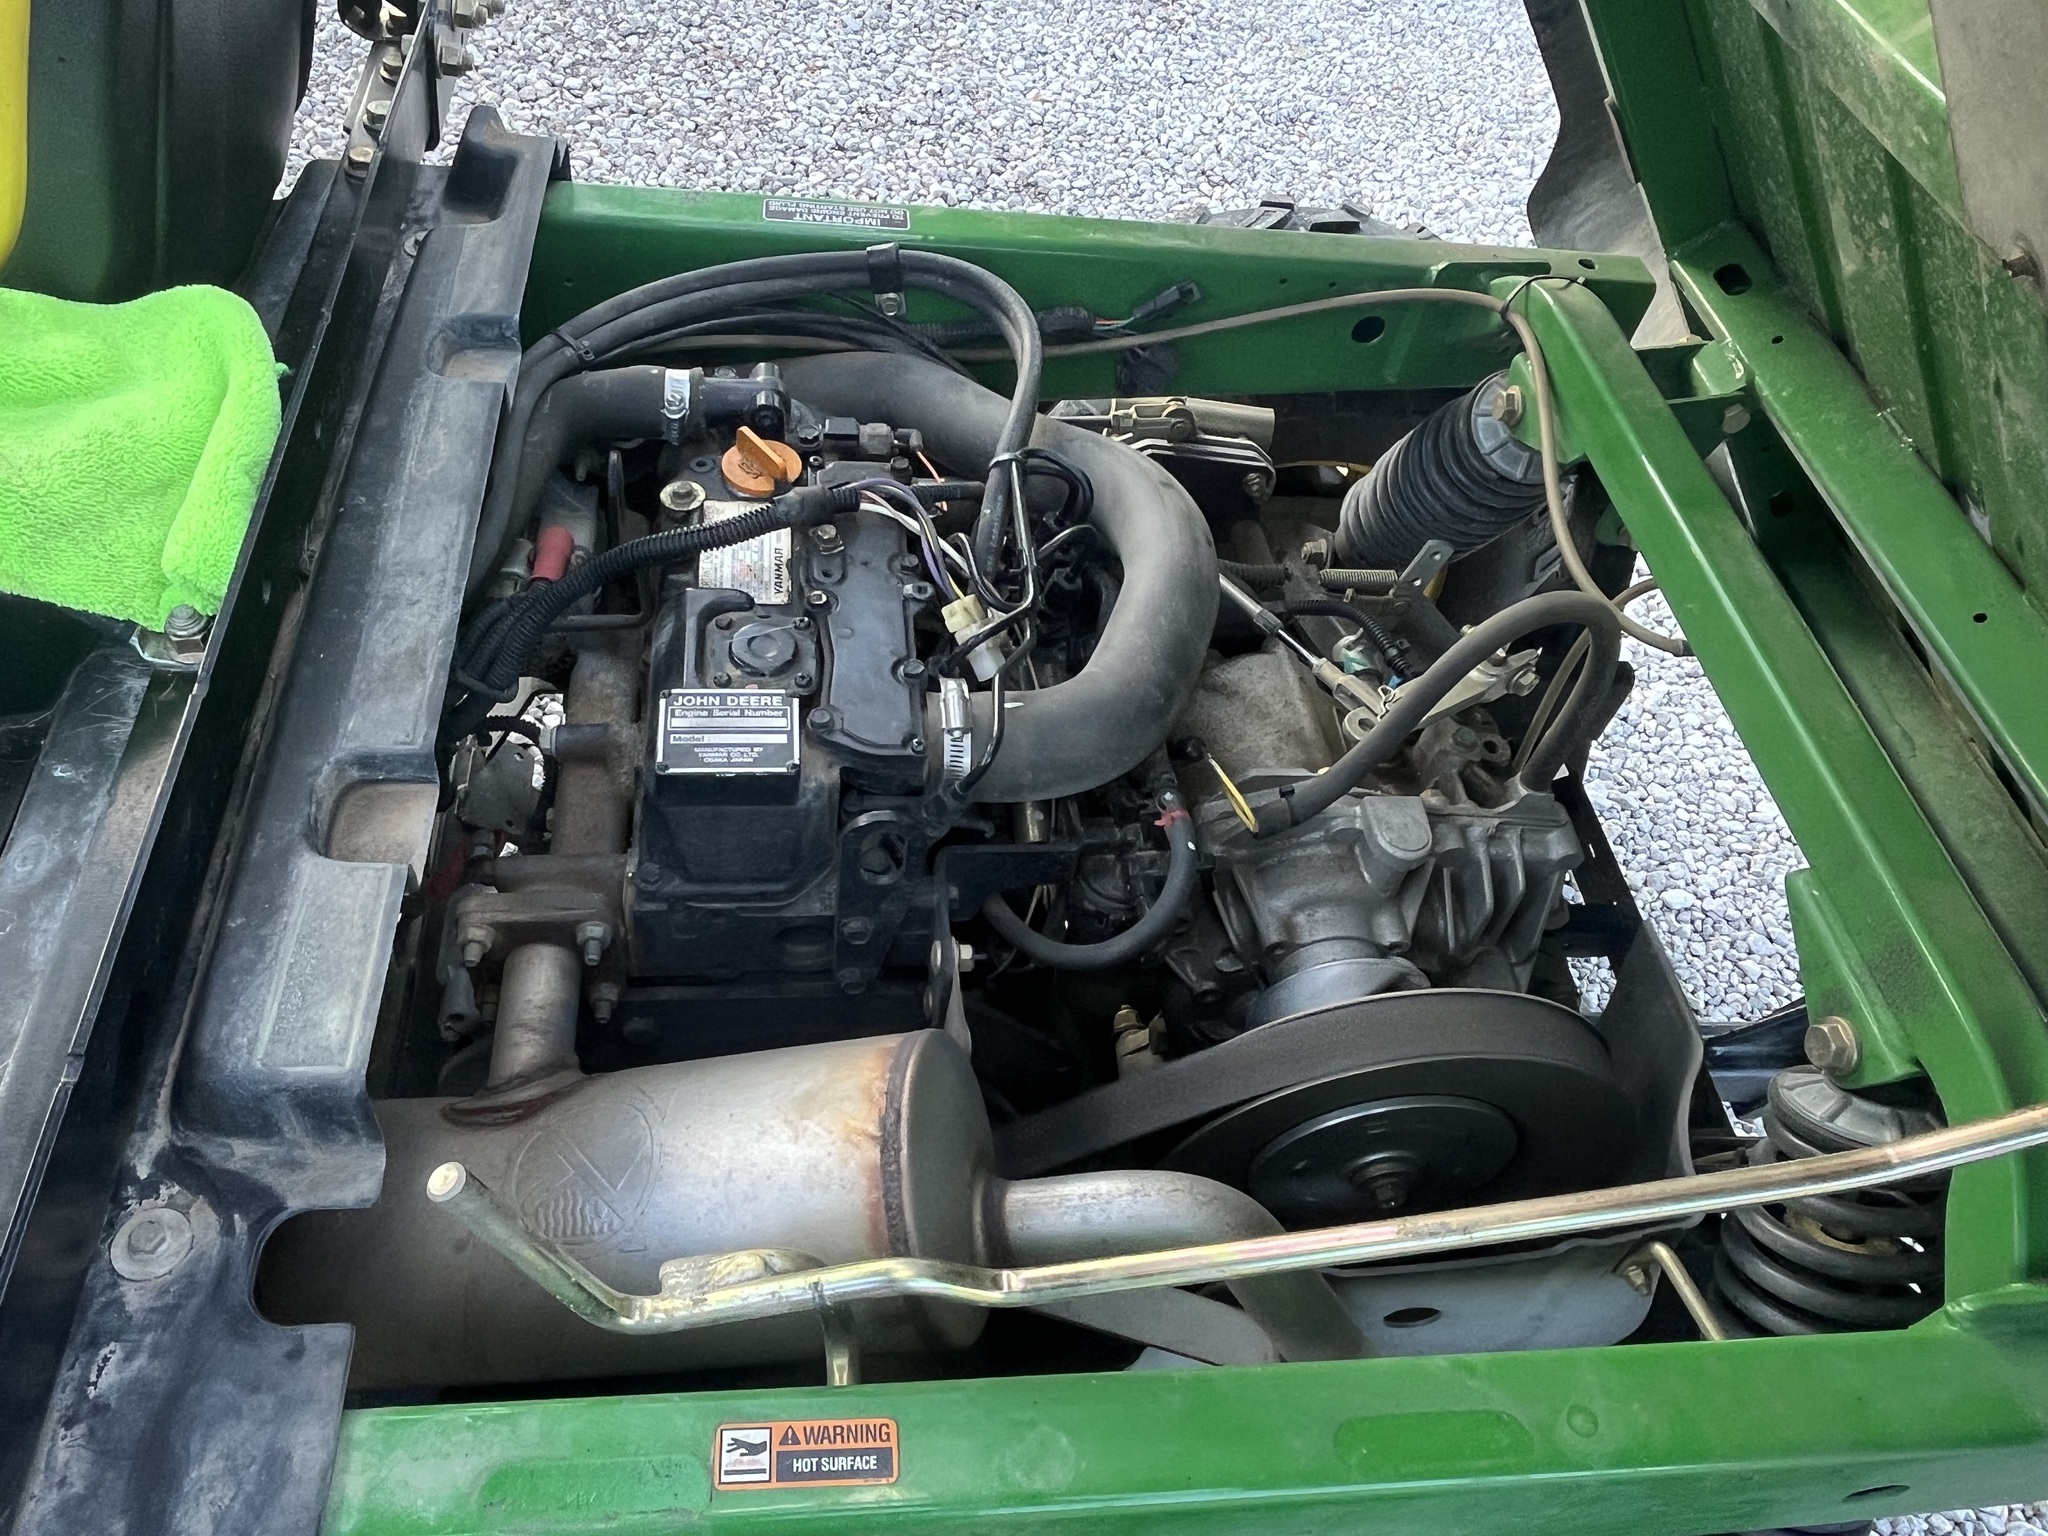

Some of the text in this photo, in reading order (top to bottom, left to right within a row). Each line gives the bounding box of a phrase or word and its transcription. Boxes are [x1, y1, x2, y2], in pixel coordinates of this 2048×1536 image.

[793, 213, 881, 226] IMPORTANT
[774, 548, 783, 594] YANMAR
[673, 695, 783, 706] JOHN DEERE
[674, 709, 784, 718] Engine Serial Number
[672, 735, 705, 743] Model
[803, 1423, 891, 1445] WARNING
[792, 1455, 878, 1473] HOT SURFACE
